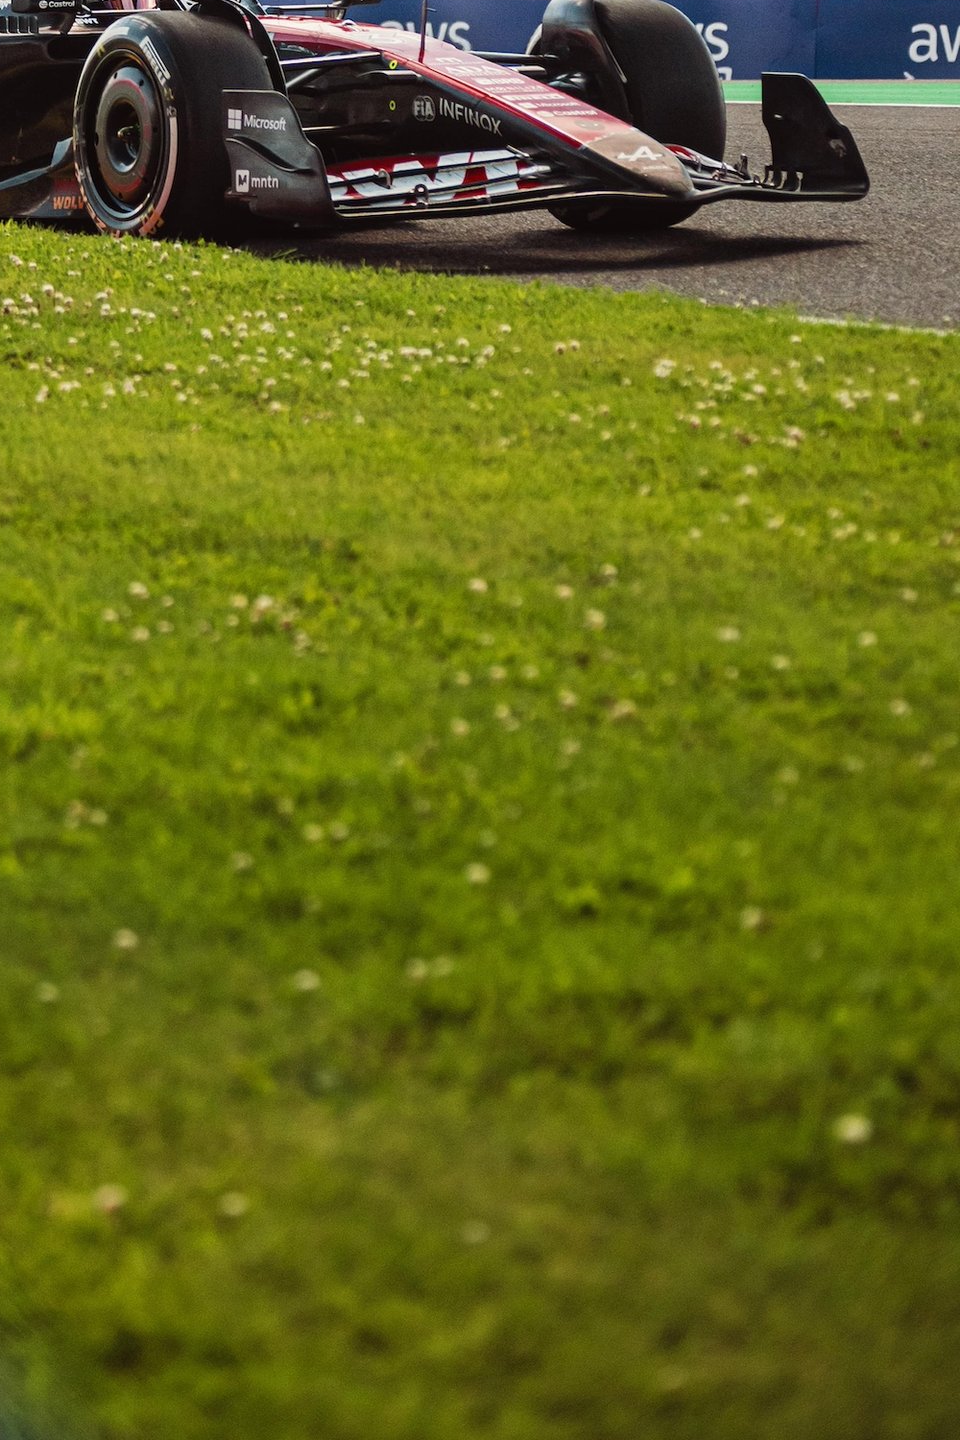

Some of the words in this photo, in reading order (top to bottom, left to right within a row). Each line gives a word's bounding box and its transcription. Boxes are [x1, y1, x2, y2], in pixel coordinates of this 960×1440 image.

[48, 0, 75, 8] Castrol
[243, 114, 286, 131] Microsoft
[440, 98, 503, 136] INFINOX
[251, 176, 279, 188] mntn
